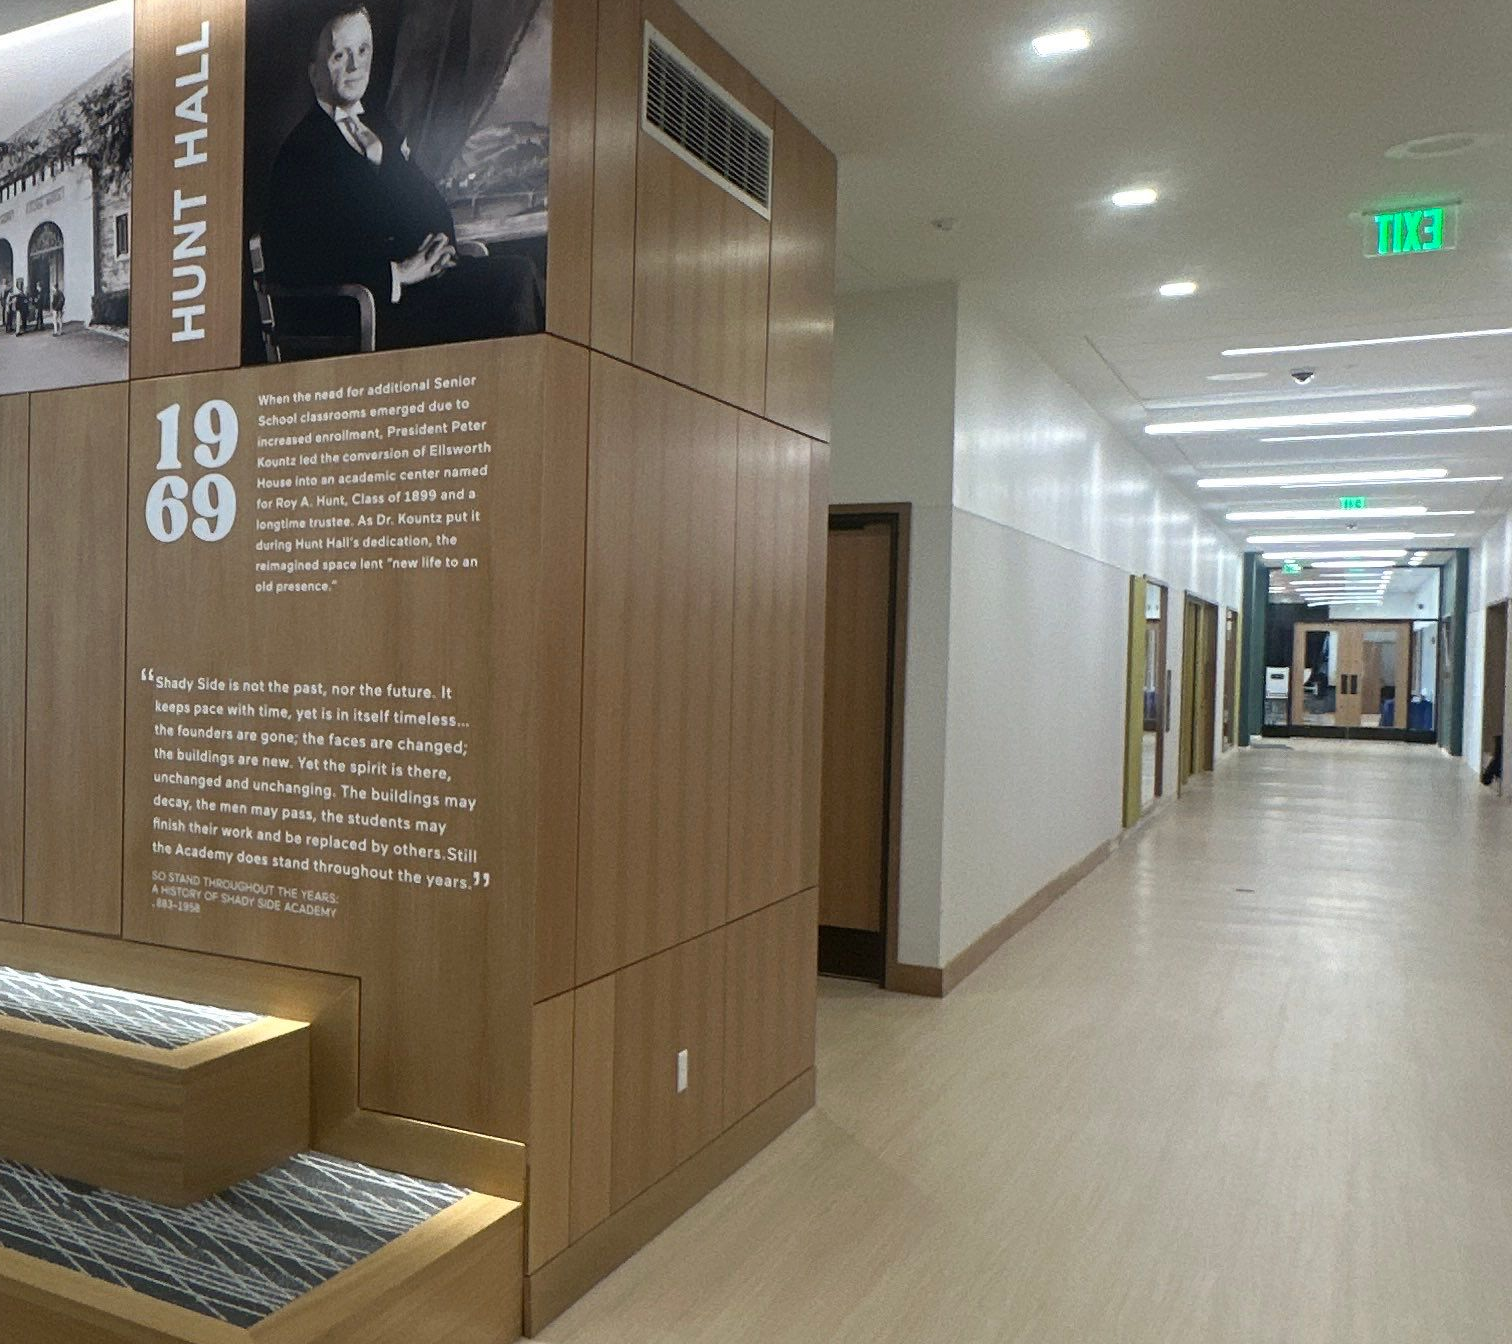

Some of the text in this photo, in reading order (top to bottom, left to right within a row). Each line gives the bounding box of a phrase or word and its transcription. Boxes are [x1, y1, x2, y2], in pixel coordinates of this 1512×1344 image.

[172, 21, 209, 342] HUNT HALL
[258, 375, 476, 406] When the need for additional Senior
[258, 399, 470, 426] School classrooms emerged due to
[156, 400, 238, 470] 19
[257, 432, 312, 447] increased
[387, 422, 448, 437] President
[451, 420, 487, 432] Peter
[257, 441, 491, 468] Kountz led the conversion of Ellsworth
[256, 464, 488, 488] House into an academic center named
[146, 474, 236, 542] 69
[256, 498, 273, 509] for
[275, 497, 298, 510] Roy
[351, 492, 384, 505] Class
[387, 490, 401, 503] of
[404, 489, 437, 502] 1899
[440, 488, 464, 501] and
[468, 489, 476, 499] a
[256, 518, 306, 532] longtime
[357, 514, 373, 526] As
[398, 512, 442, 524] Kountz
[445, 511, 468, 525] put
[471, 509, 480, 522] it
[255, 539, 292, 552] during
[295, 538, 323, 549] Hunt
[436, 533, 457, 545] the
[255, 559, 319, 573] reimagined
[322, 560, 357, 571] space
[360, 557, 383, 569] lent
[421, 556, 442, 568] life
[445, 556, 459, 568] to
[462, 558, 478, 567] an
[255, 580, 273, 592] old
[197, 677, 226, 691] Side
[228, 679, 239, 691] is
[242, 680, 264, 692] not
[267, 680, 289, 693] the
[331, 685, 356, 696] nor
[359, 683, 382, 696] the
[441, 685, 452, 699] It
[155, 700, 190, 715] keeps
[193, 704, 224, 716] pace
[227, 703, 255, 716] with
[295, 708, 317, 722] yet
[321, 706, 332, 720] is
[336, 707, 349, 721] in
[353, 708, 390, 723] itself
[154, 723, 174, 736] the
[177, 724, 233, 739] founders
[236, 730, 257, 741] are
[302, 731, 324, 745] the
[328, 732, 366, 748] faces
[370, 738, 393, 749] are
[154, 747, 173, 760] the
[176, 748, 234, 766] buildings
[237, 755, 258, 766] are
[297, 756, 320, 771] Yet
[322, 758, 346, 772] the
[350, 760, 387, 776] spirit
[391, 762, 403, 776] is
[153, 772, 222, 789] unchanged
[225, 777, 249, 790] and
[340, 784, 366, 799] The
[371, 787, 440, 808] buildings
[444, 796, 476, 811] may
[195, 798, 216, 811] the
[219, 802, 247, 814] men
[250, 805, 278, 819] may
[320, 809, 344, 823] the
[347, 813, 411, 829] students
[415, 820, 446, 836] may
[152, 816, 186, 831] finish
[188, 821, 218, 835] their
[221, 826, 253, 839] work
[256, 829, 281, 842] and
[285, 830, 302, 844] be
[306, 835, 367, 851] replaced
[371, 839, 389, 856] by
[152, 841, 172, 854] the
[174, 843, 233, 863] Academy
[236, 850, 268, 865] does
[272, 856, 309, 870] stand
[312, 860, 393, 880] throughout
[397, 869, 422, 883] the
